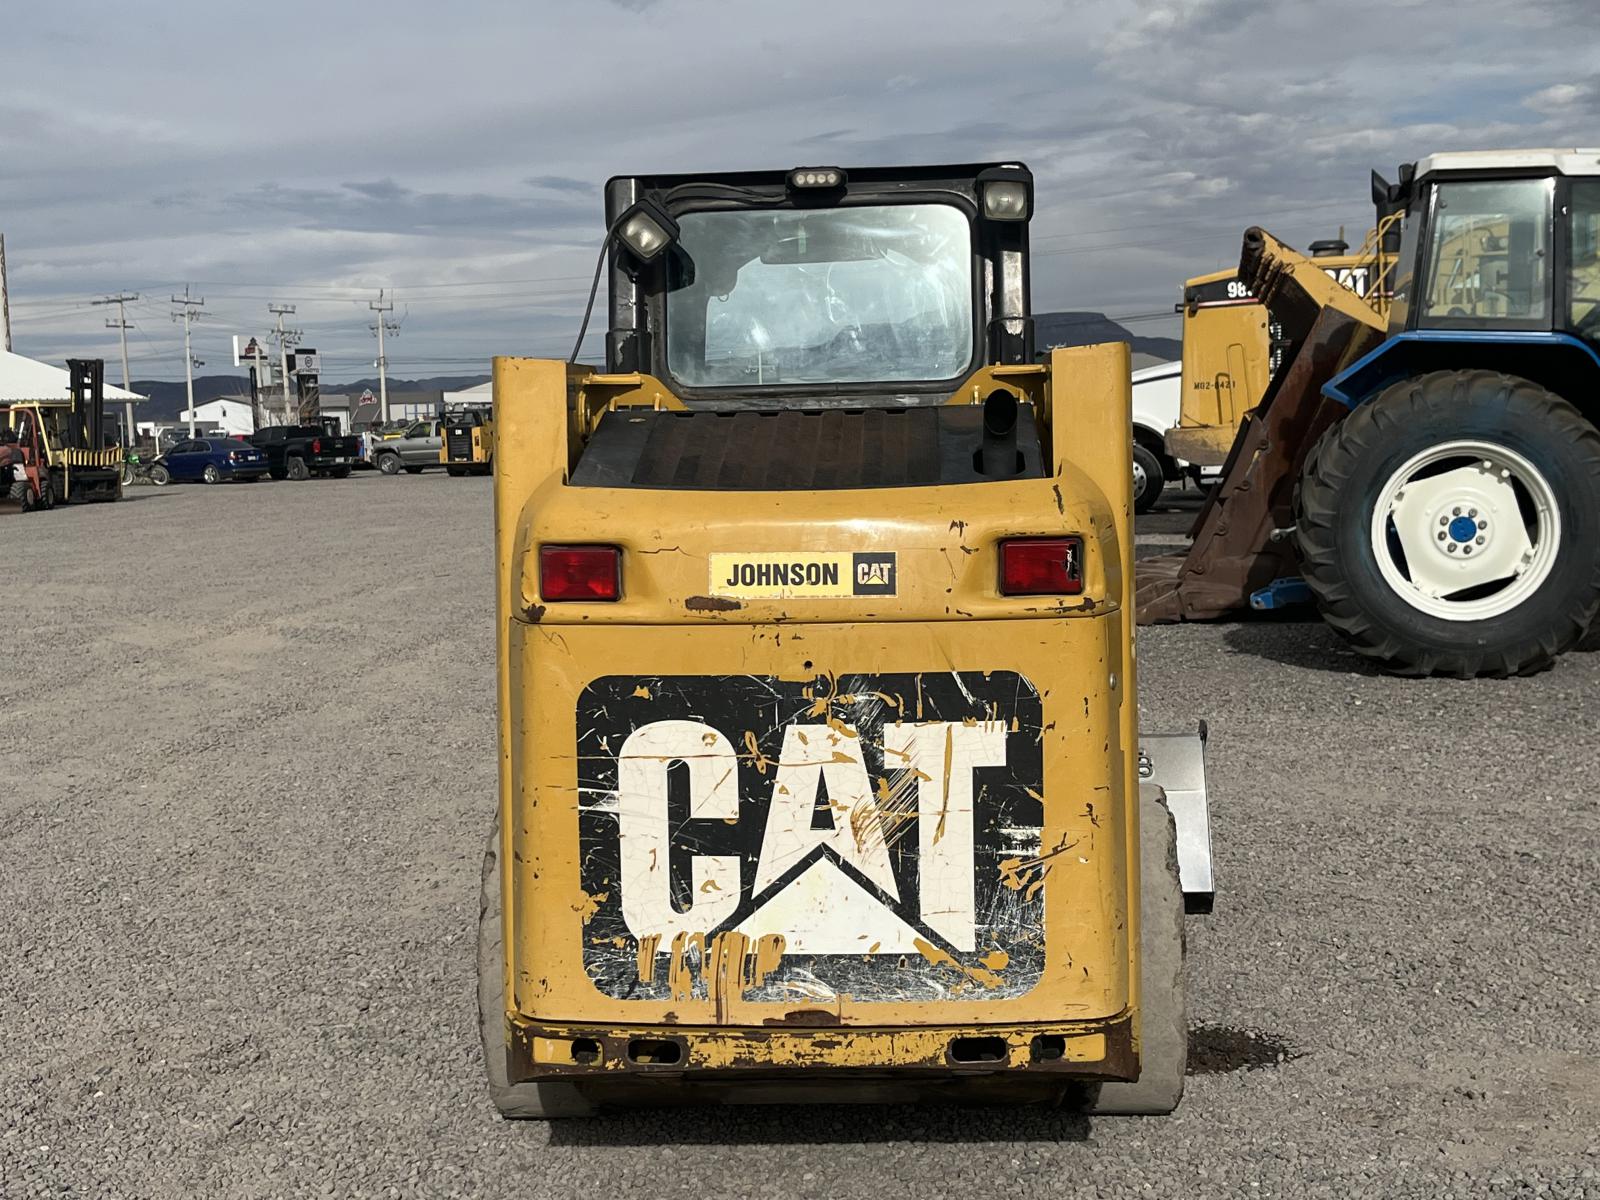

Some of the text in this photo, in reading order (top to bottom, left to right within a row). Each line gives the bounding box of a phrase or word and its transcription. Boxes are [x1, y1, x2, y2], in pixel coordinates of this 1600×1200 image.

[1227, 281, 1253, 298] 98
[1324, 268, 1368, 297] AT
[726, 563, 892, 586] JOHNSON CAT
[618, 720, 1007, 954] CAT
